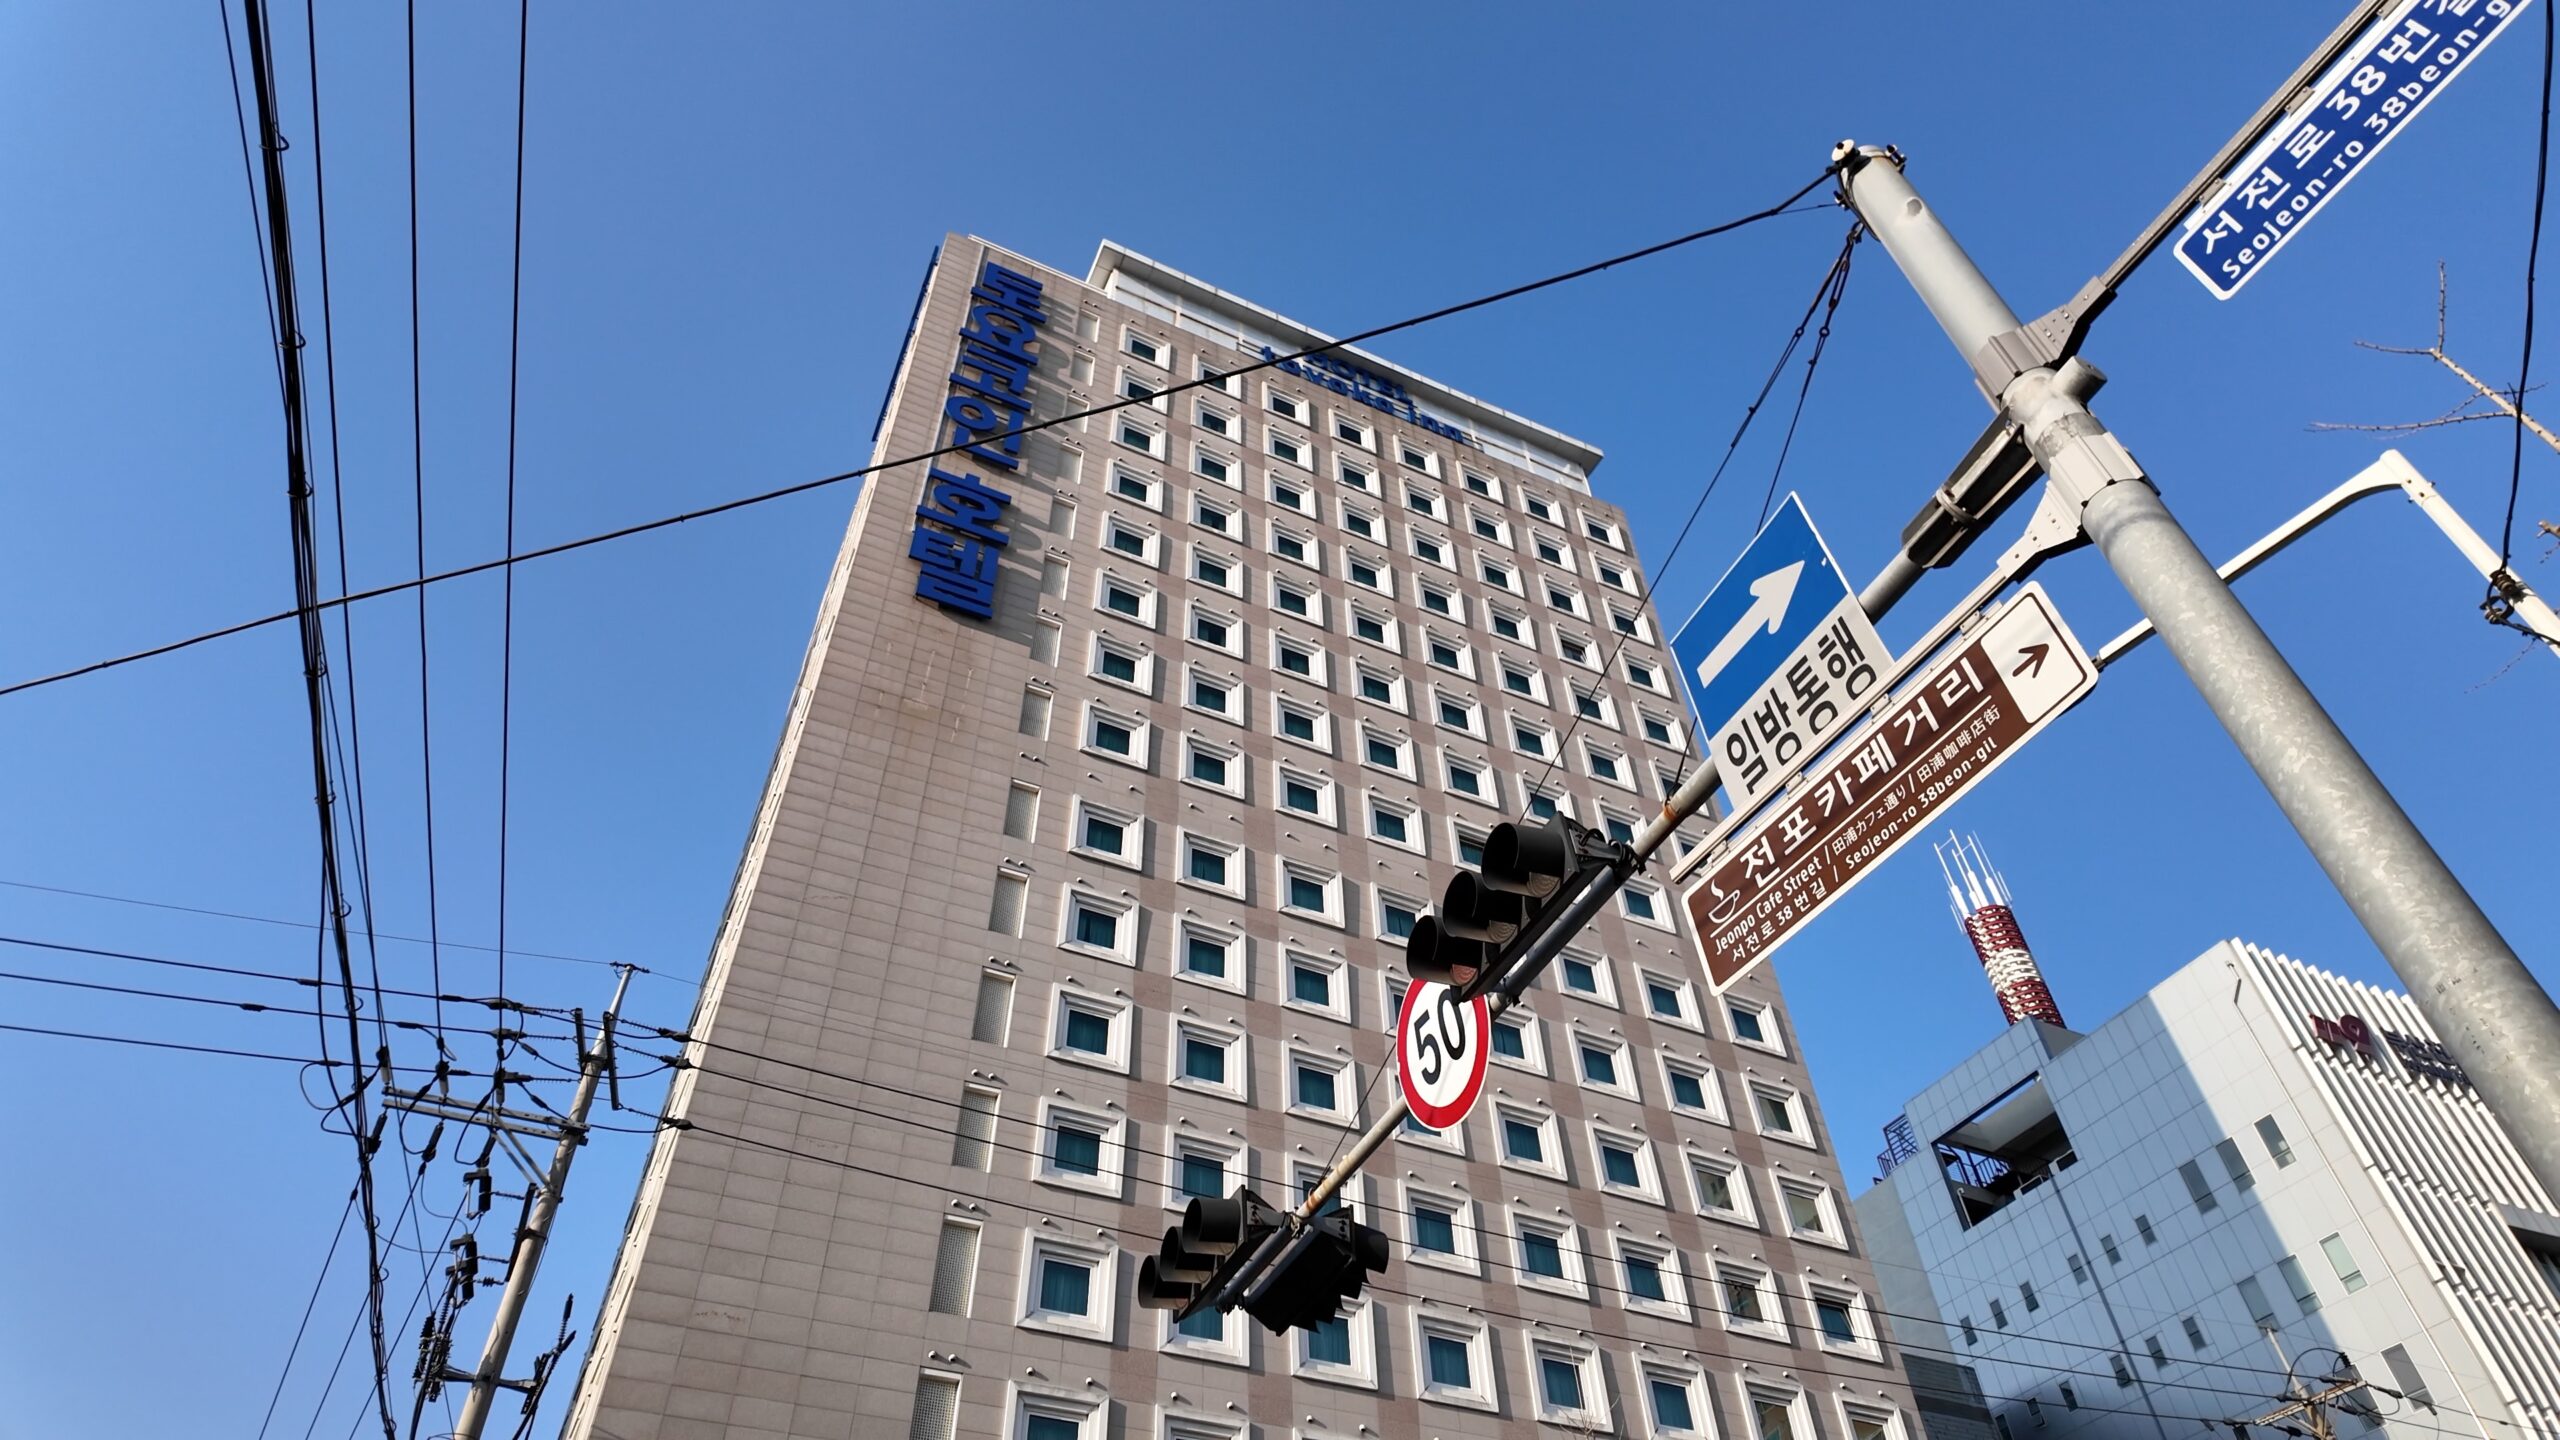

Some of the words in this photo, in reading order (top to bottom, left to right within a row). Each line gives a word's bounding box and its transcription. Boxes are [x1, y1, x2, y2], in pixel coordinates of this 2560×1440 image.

[2222, 140, 2364, 279] Seojeon-ro
[908, 467, 1012, 620] 호텔
[1726, 616, 1877, 795] 일방통행
[1845, 805, 1917, 870] Seojeon-ro
[1917, 736, 1998, 809] 38beon-gil
[1715, 914, 1756, 956] Jeonpo
[1756, 890, 1784, 919] Cafe
[1783, 855, 1823, 897] Street
[1413, 988, 1466, 1086] 50
